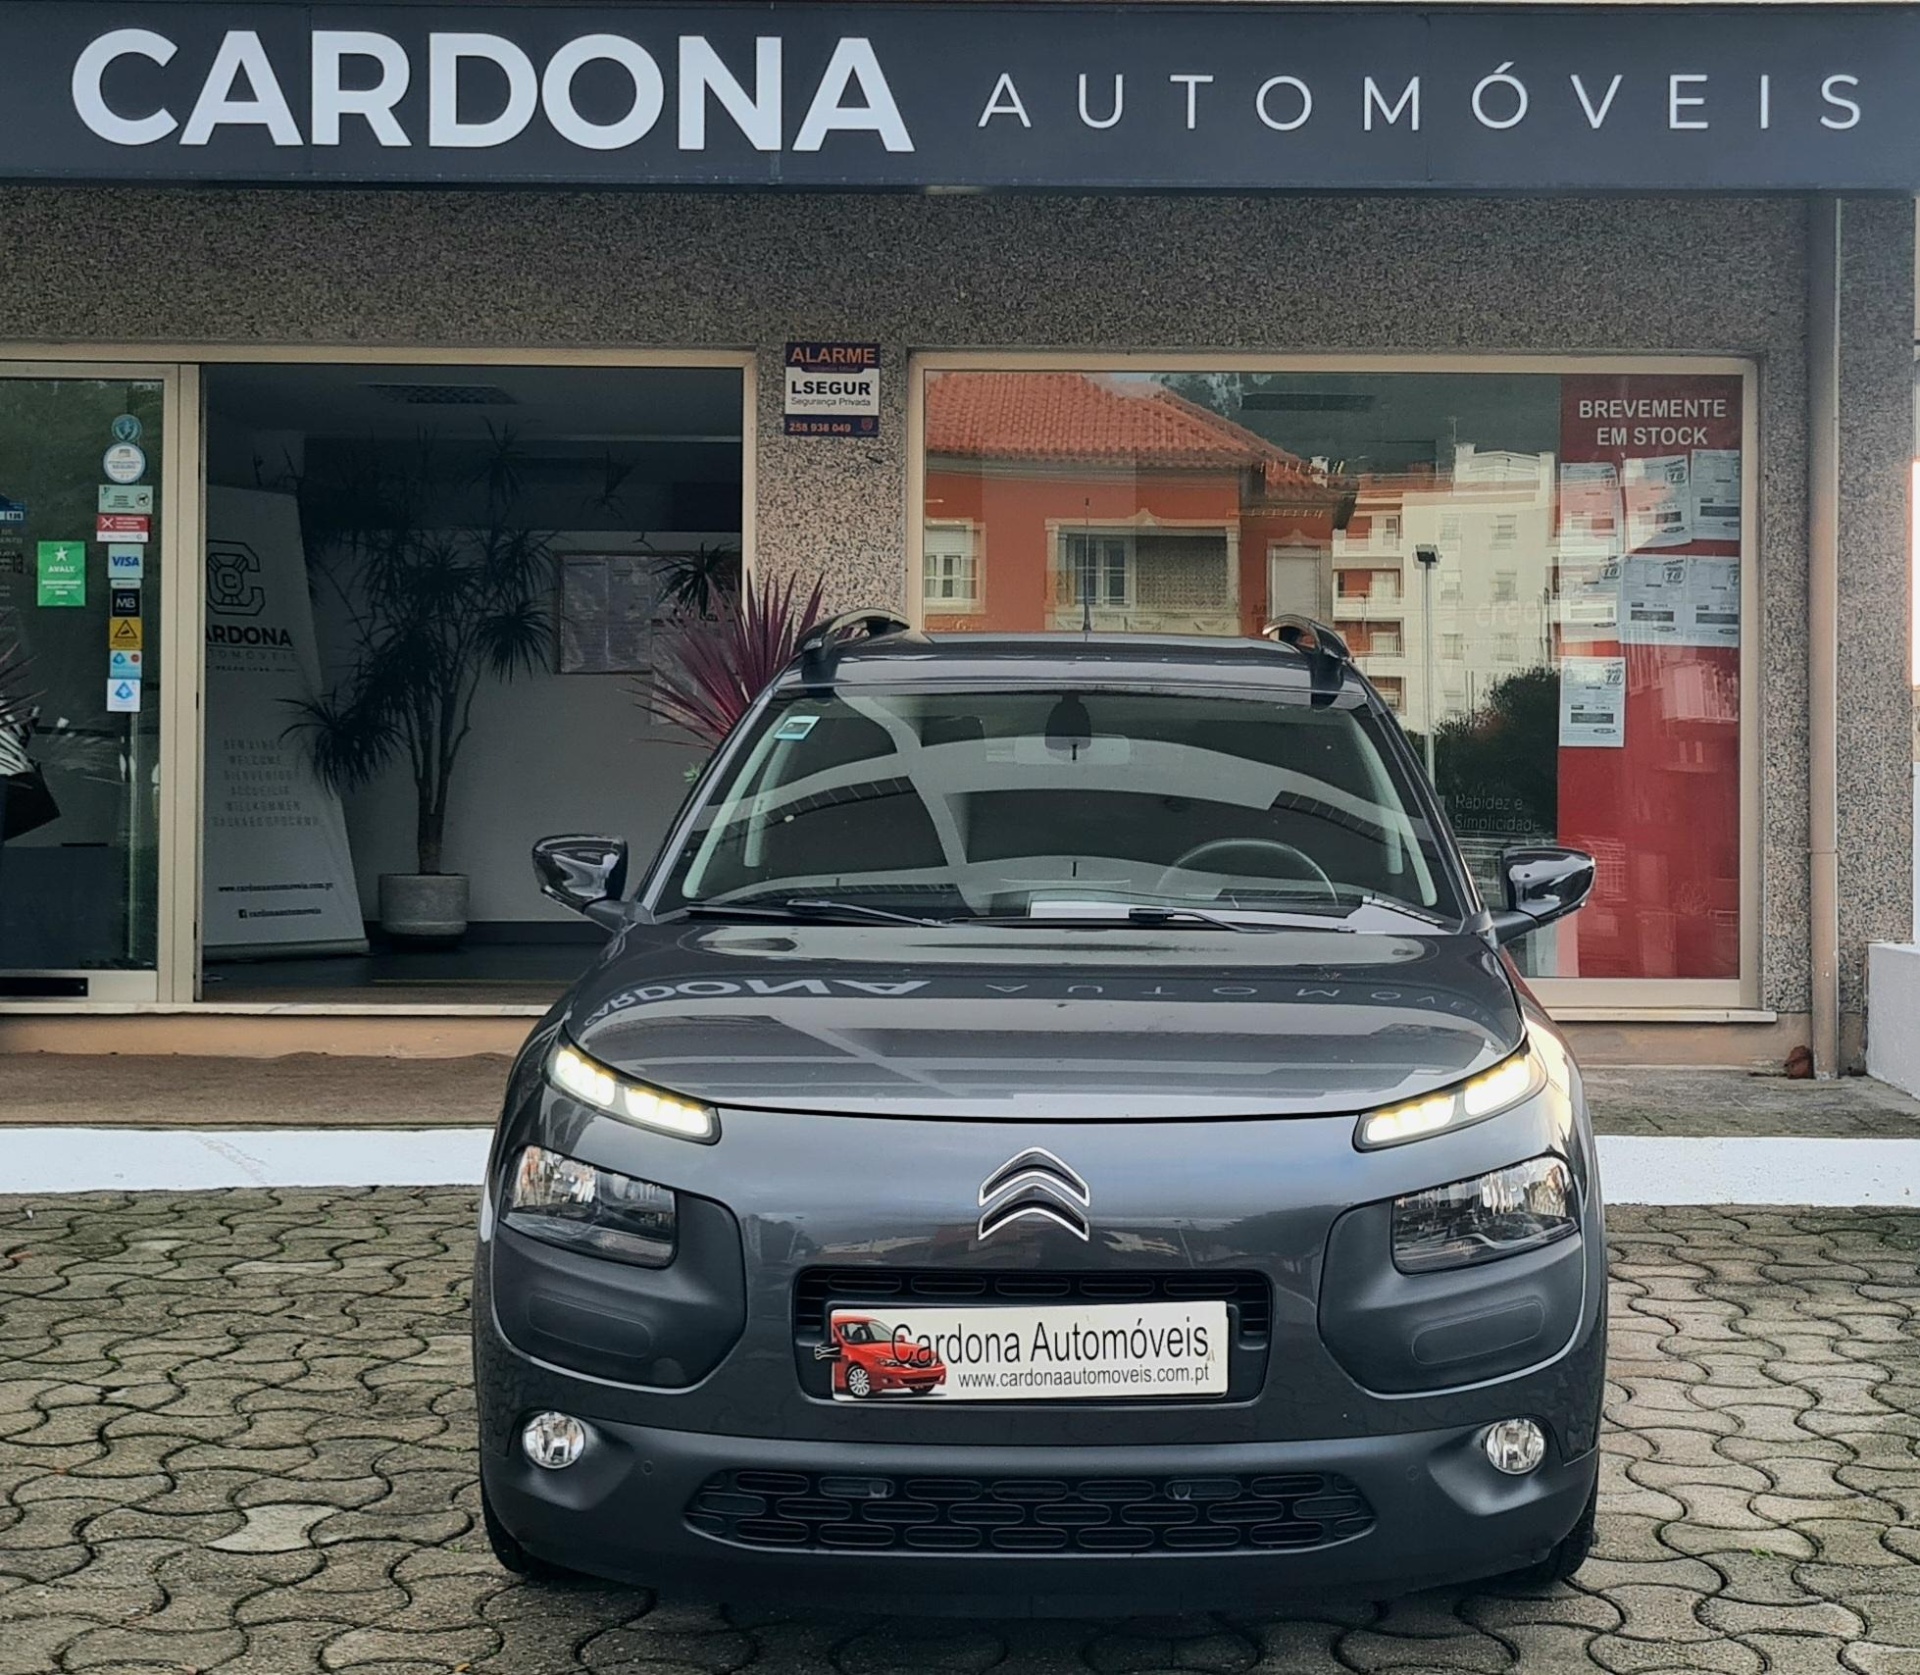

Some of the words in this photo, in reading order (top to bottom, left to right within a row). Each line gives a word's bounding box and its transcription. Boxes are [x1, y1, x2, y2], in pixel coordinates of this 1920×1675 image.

[72, 28, 915, 152] CARDONA
[978, 62, 1860, 132] AUTOMÓVEIS
[790, 346, 876, 364] ALARME
[791, 381, 871, 396] LSEGUR
[791, 396, 837, 409] Segurança
[838, 397, 871, 408] Privada
[1579, 399, 1727, 418] BREVEMENTE
[1597, 427, 1627, 446] EM
[1633, 426, 1708, 446] STOCK
[112, 556, 140, 567] VISA
[116, 598, 135, 608] MB
[892, 1323, 1020, 1366] Cardona
[1030, 1316, 1209, 1362] Automóveis
[958, 1362, 1210, 1388] www.cardonaautomoveis.com.pt
